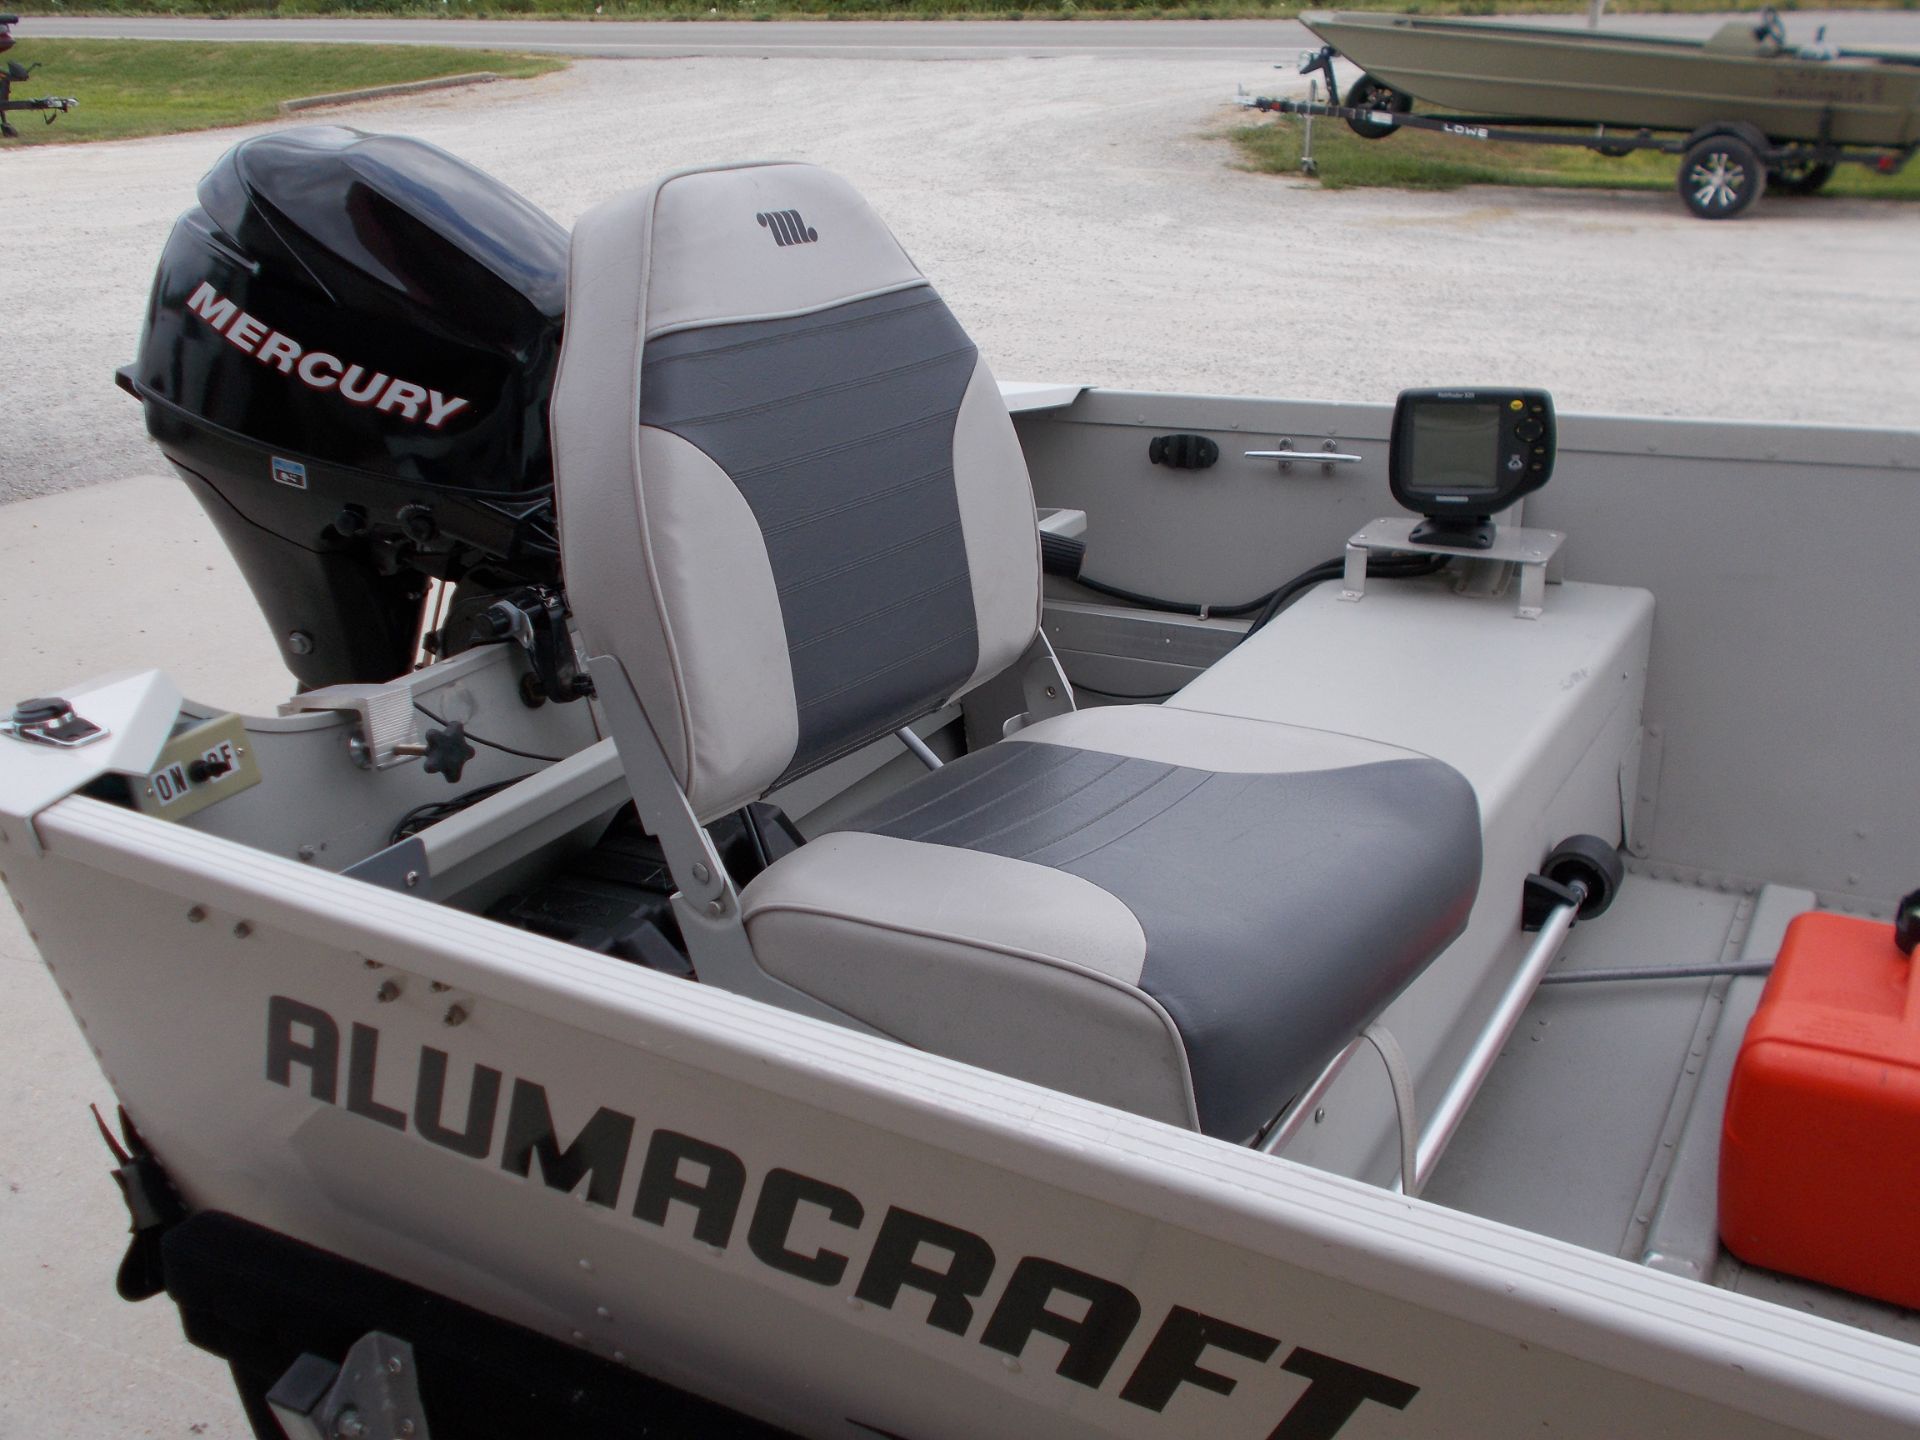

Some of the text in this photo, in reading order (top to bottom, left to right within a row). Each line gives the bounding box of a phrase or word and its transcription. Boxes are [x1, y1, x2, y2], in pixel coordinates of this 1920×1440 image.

[1443, 122, 1488, 138] LOWE
[185, 280, 470, 428] MERCURY
[155, 765, 188, 801] ON
[265, 994, 1421, 1440] ALUMACRAFT
